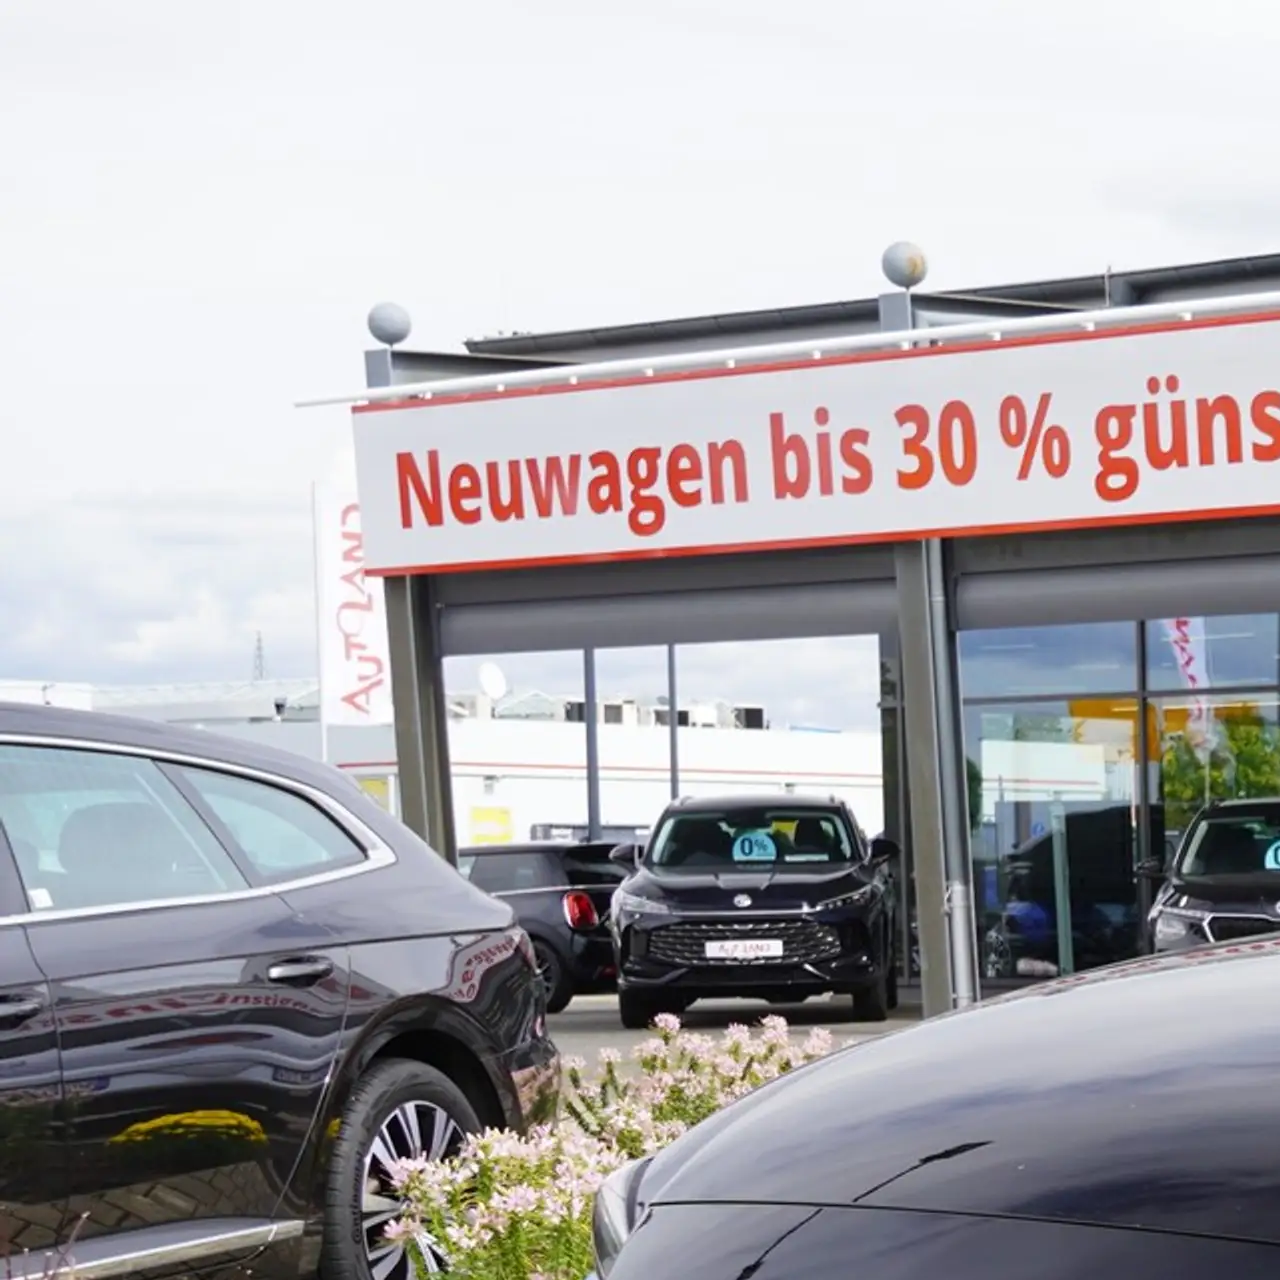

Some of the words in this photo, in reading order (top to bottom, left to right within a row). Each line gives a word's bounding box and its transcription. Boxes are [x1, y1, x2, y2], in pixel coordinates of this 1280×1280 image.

[396, 440, 748, 537] Neuwagen
[770, 407, 873, 498] bis
[895, 401, 977, 490] 30
[999, 393, 1070, 481] %
[740, 837, 768, 857] 0%
